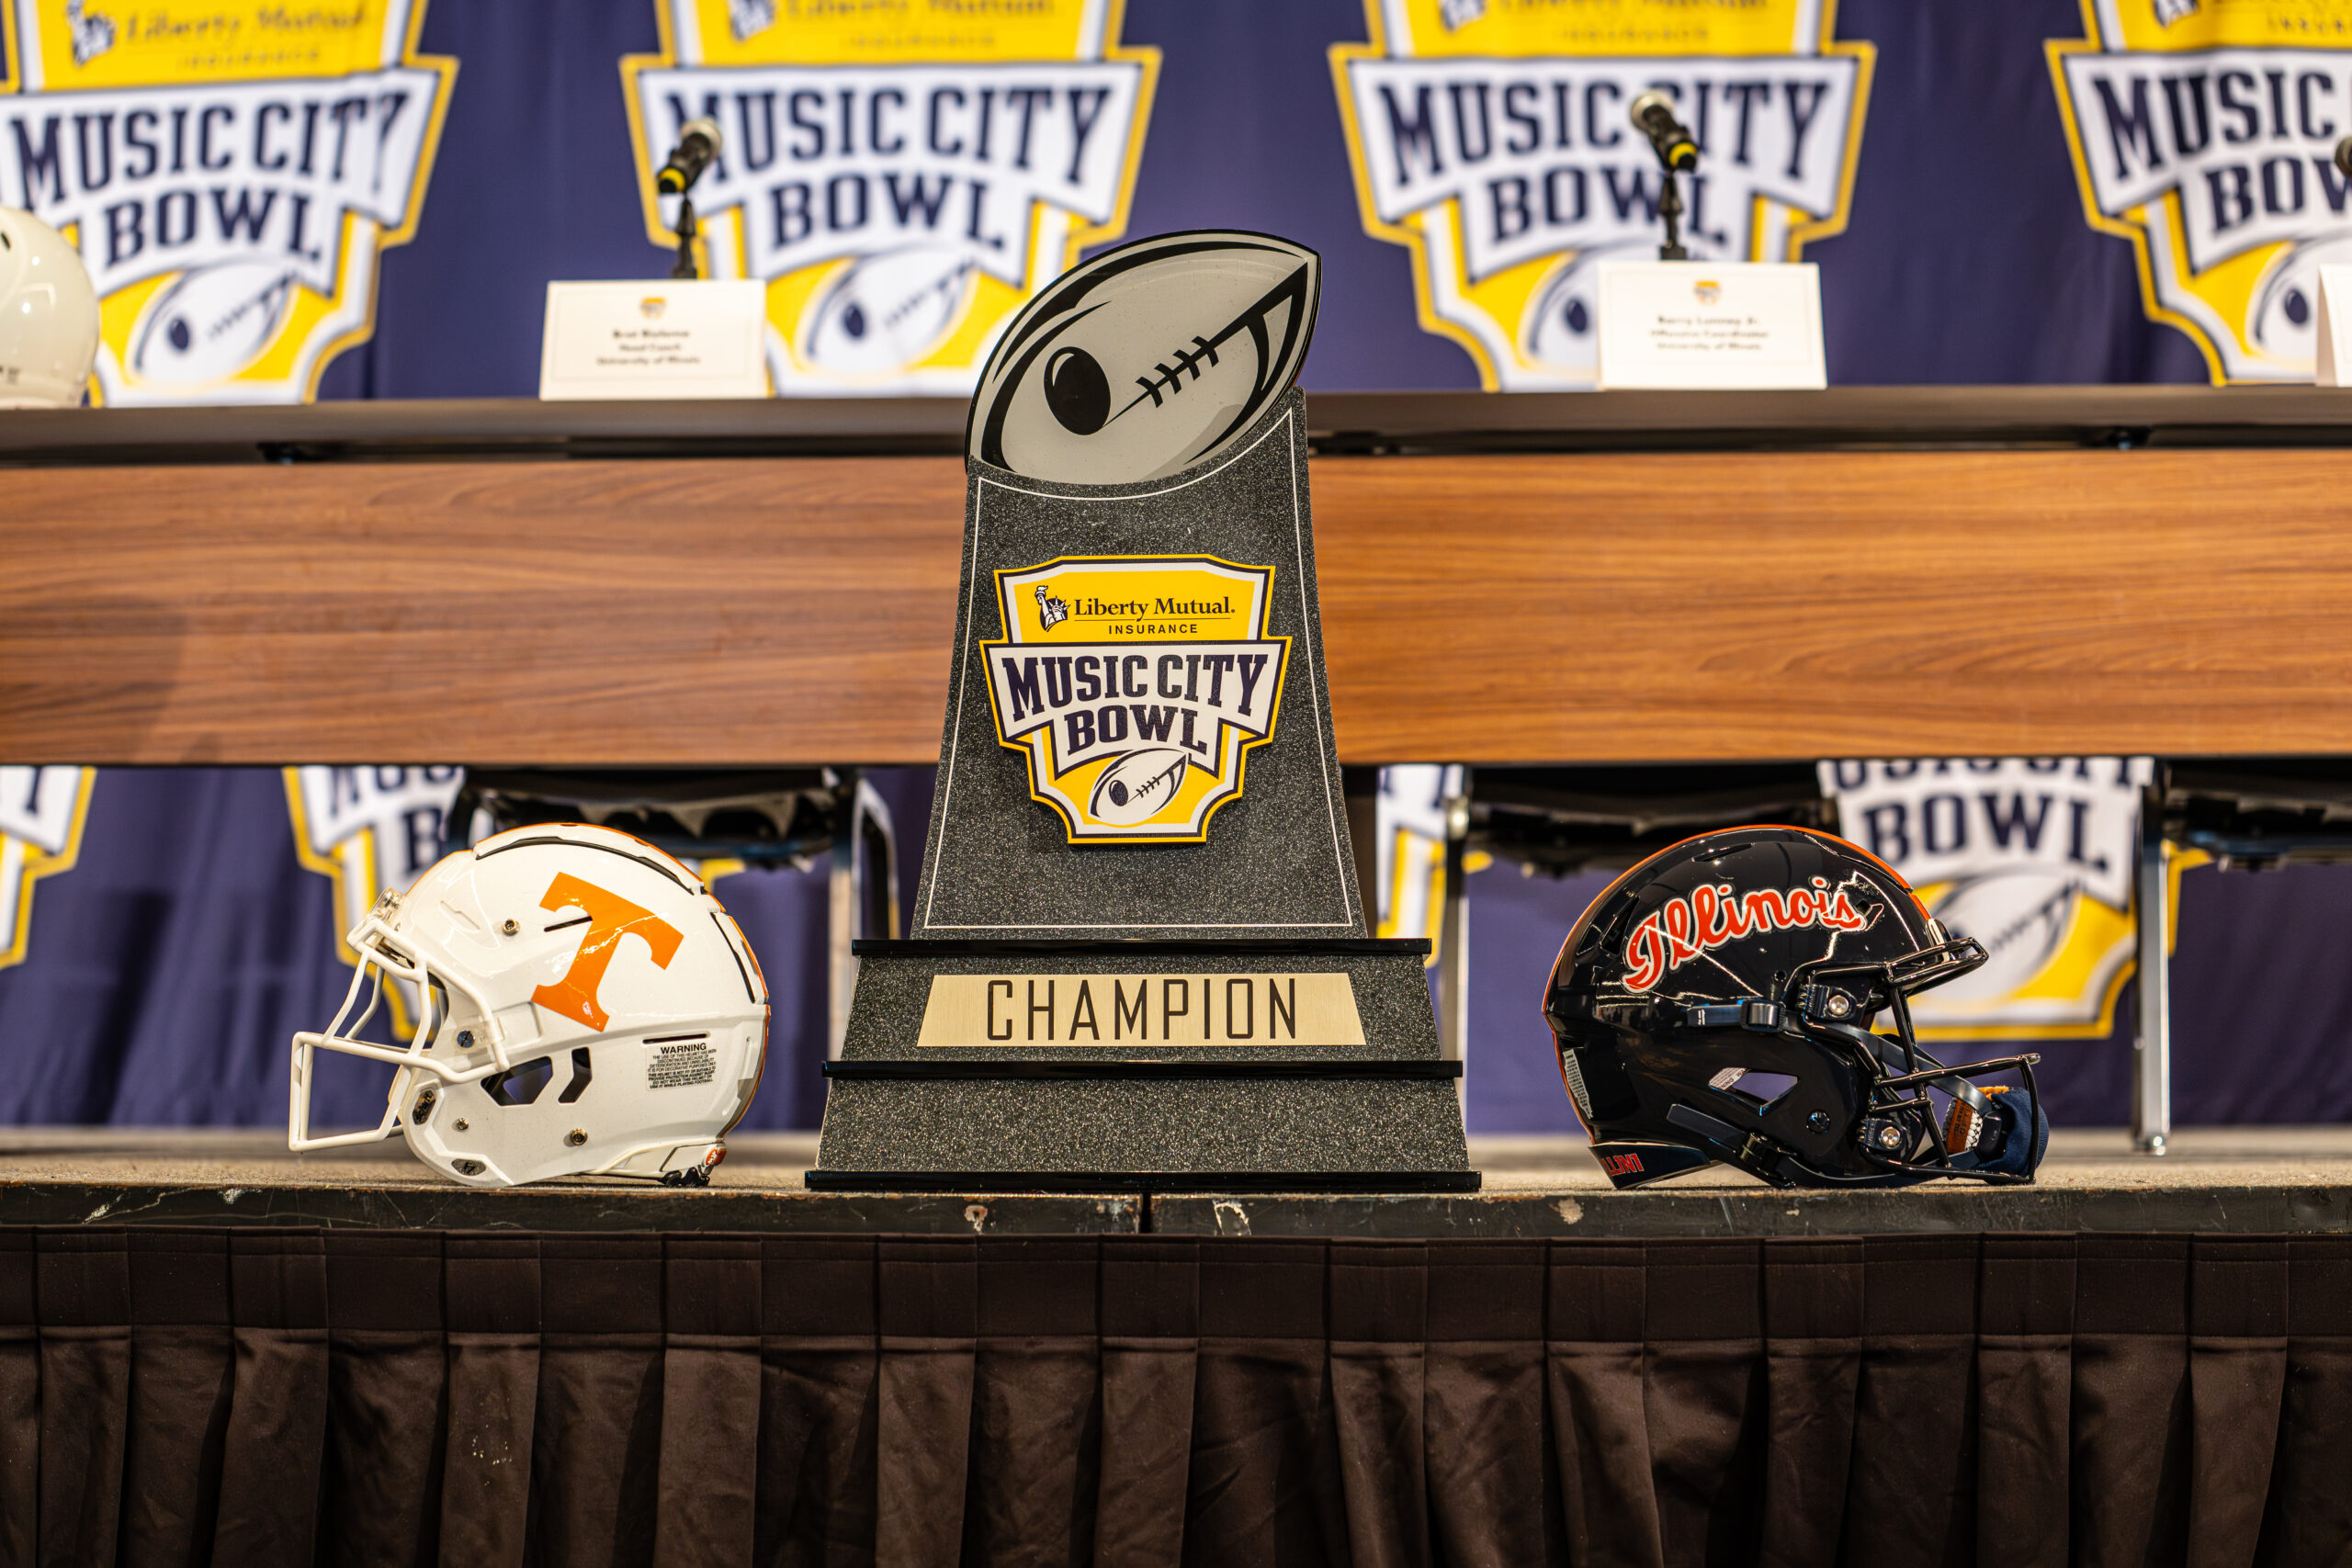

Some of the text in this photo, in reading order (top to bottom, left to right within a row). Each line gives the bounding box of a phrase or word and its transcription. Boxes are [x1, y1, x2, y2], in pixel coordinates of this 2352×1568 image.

[10, 92, 410, 210] MUSIC CITY
[928, 86, 1112, 185] CITY
[1380, 80, 1622, 186] MUSIC
[2093, 70, 2335, 181] MUSIC
[105, 186, 321, 267] BOWL
[770, 174, 1003, 249] BOWL
[1488, 166, 1727, 244] BOWL
[1074, 597, 1148, 622] Liberty
[1108, 624, 1198, 635] INSURANCE
[1001, 653, 1268, 723] MUSIC CITY
[1064, 705, 1207, 756] BOWL
[1864, 793, 2108, 872] BOWL
[1622, 875, 1868, 993] Illinois
[987, 978, 1295, 1041] CHAMPION
[661, 1043, 707, 1055] WARNING
[1600, 1153, 1644, 1176] LLINI
